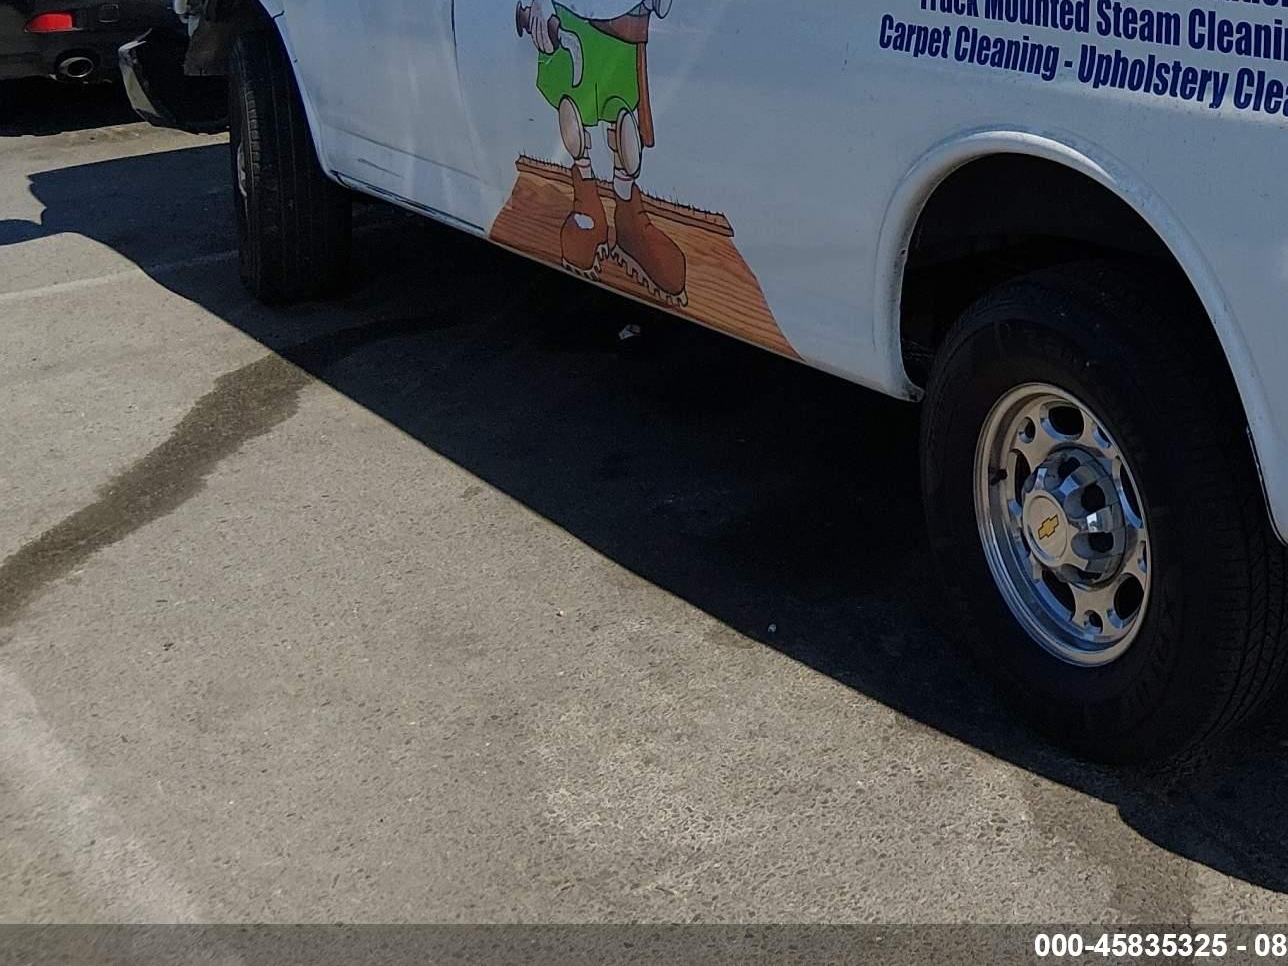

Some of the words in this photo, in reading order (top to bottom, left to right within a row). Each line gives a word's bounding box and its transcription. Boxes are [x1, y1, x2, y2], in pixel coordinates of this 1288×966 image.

[879, 14, 952, 60] Carpet
[954, 25, 1060, 81] Cleaning
[1077, 44, 1229, 109] Upholstery
